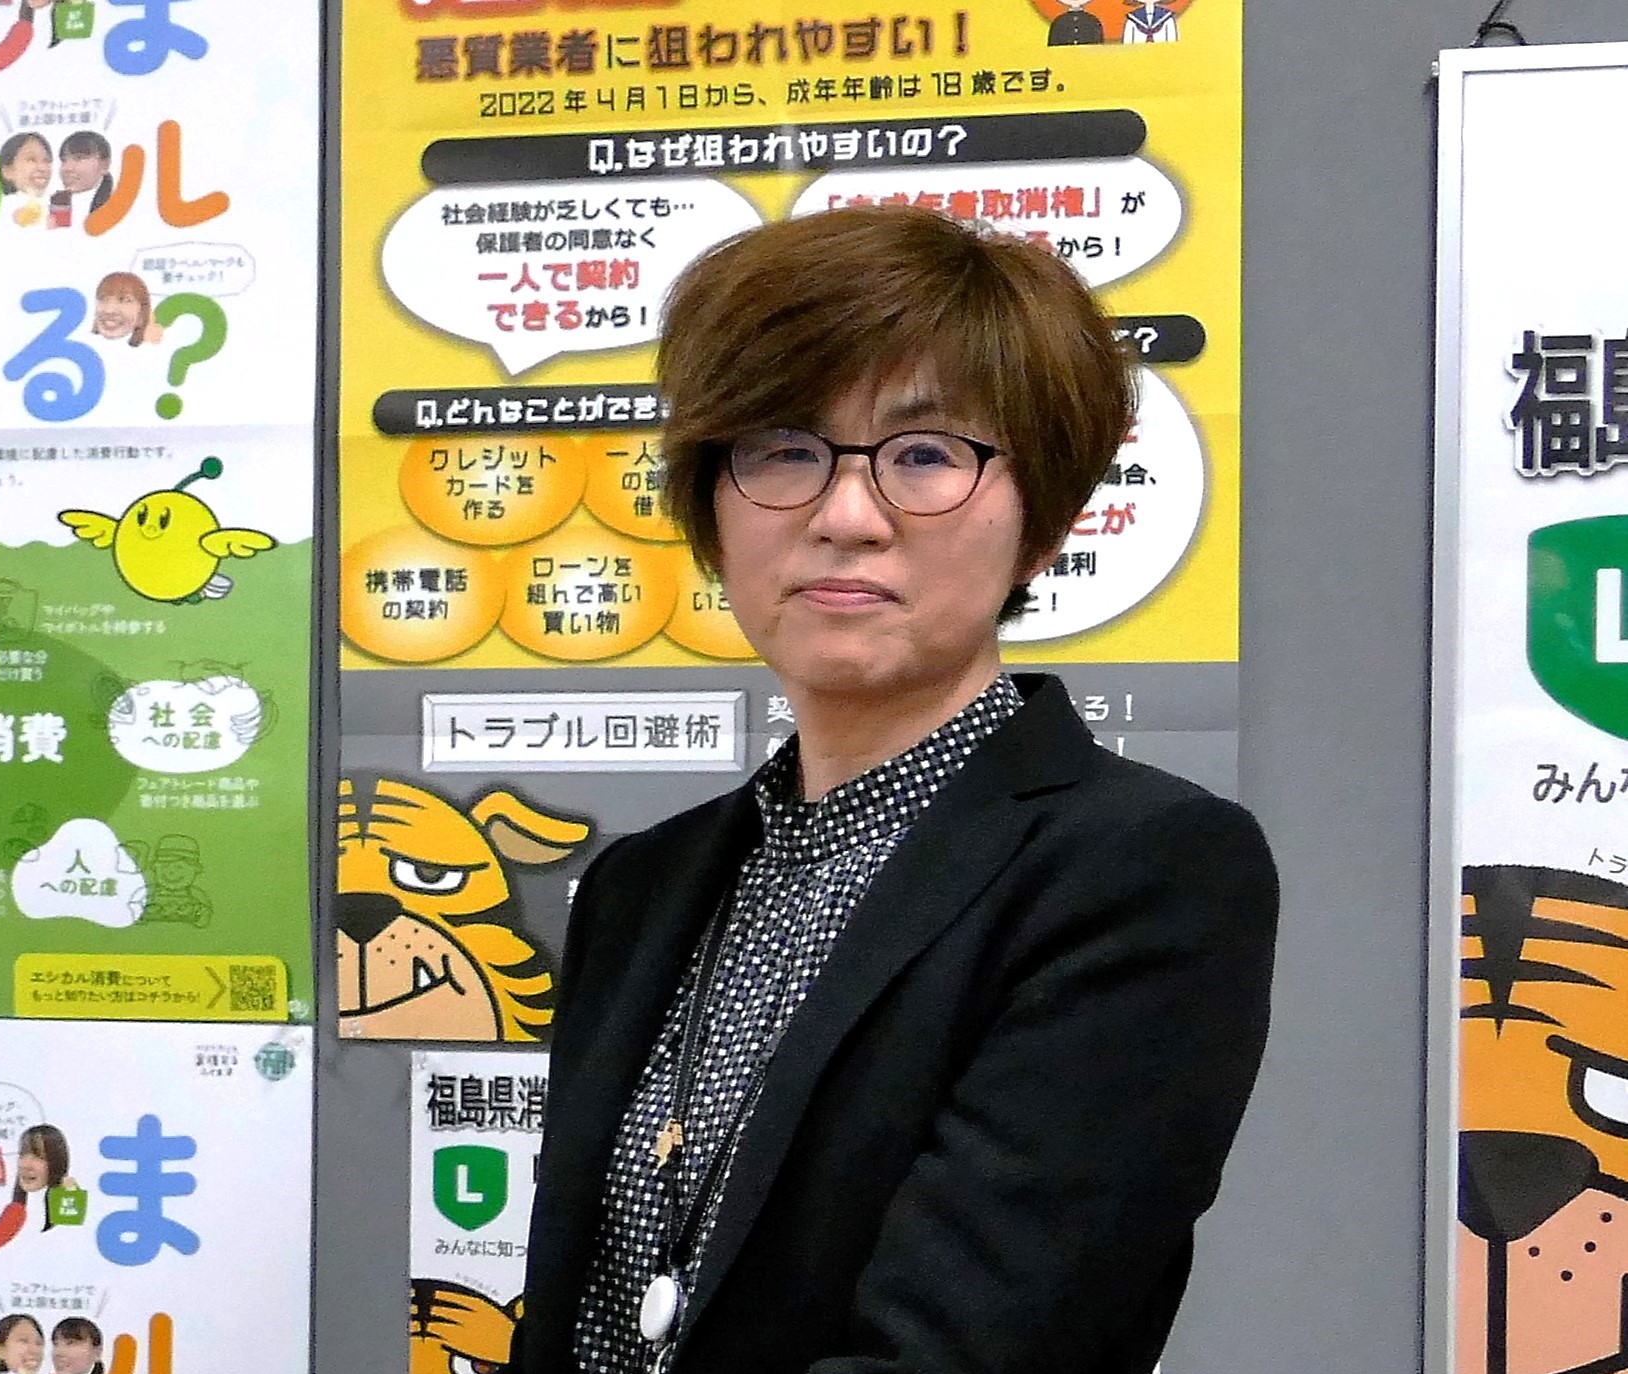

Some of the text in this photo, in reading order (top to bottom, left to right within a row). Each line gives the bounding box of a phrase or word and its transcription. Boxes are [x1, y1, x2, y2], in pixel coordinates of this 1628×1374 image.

[415, 12, 969, 82] 悪質業者に狙われやすい！
[476, 227, 656, 254] 保護者の同意なく
[478, 258, 640, 292] 一人で契約
[487, 300, 647, 332] できるから！
[415, 395, 670, 429] Q.どんなことができ
[429, 446, 557, 472] クレジット
[446, 475, 534, 496] カードを
[463, 500, 506, 520] 作る
[533, 555, 632, 578] ローンを
[366, 568, 468, 593] 携帯電話
[527, 582, 641, 605] 組んで高い
[383, 600, 448, 620] の契約
[543, 612, 621, 634] 買い物
[149, 702, 216, 728] 社会
[142, 732, 222, 751] への配慮
[446, 713, 722, 751] トラブル回避術
[66, 849, 91, 873] 人
[40, 879, 117, 897] への配慮
[457, 1165, 484, 1203] L
